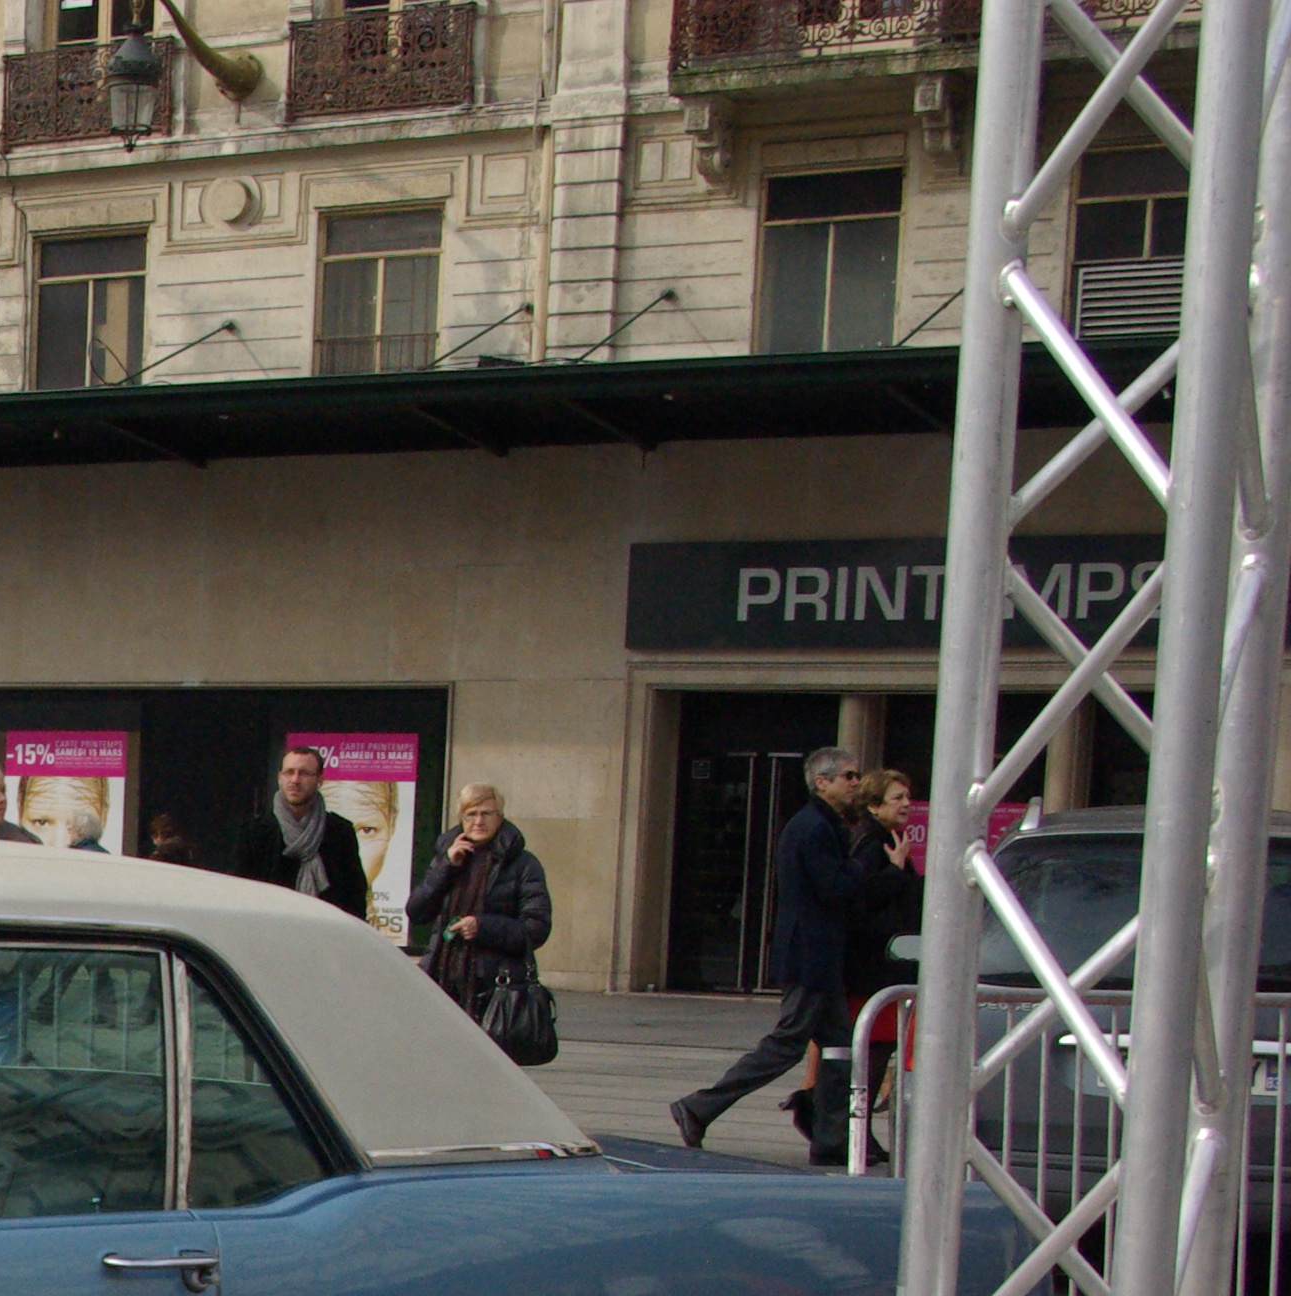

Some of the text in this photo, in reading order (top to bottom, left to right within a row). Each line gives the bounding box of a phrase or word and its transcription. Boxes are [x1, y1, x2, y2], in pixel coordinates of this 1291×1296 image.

[55, 740, 124, 749] CARTE PRINTEMPS
[339, 742, 414, 752] CARTE PRINTEMPS
[6, 743, 55, 766] -15%
[55, 748, 123, 757] SAMEDI 15 MARS
[339, 751, 414, 760] SAMEDI 15 MARS
